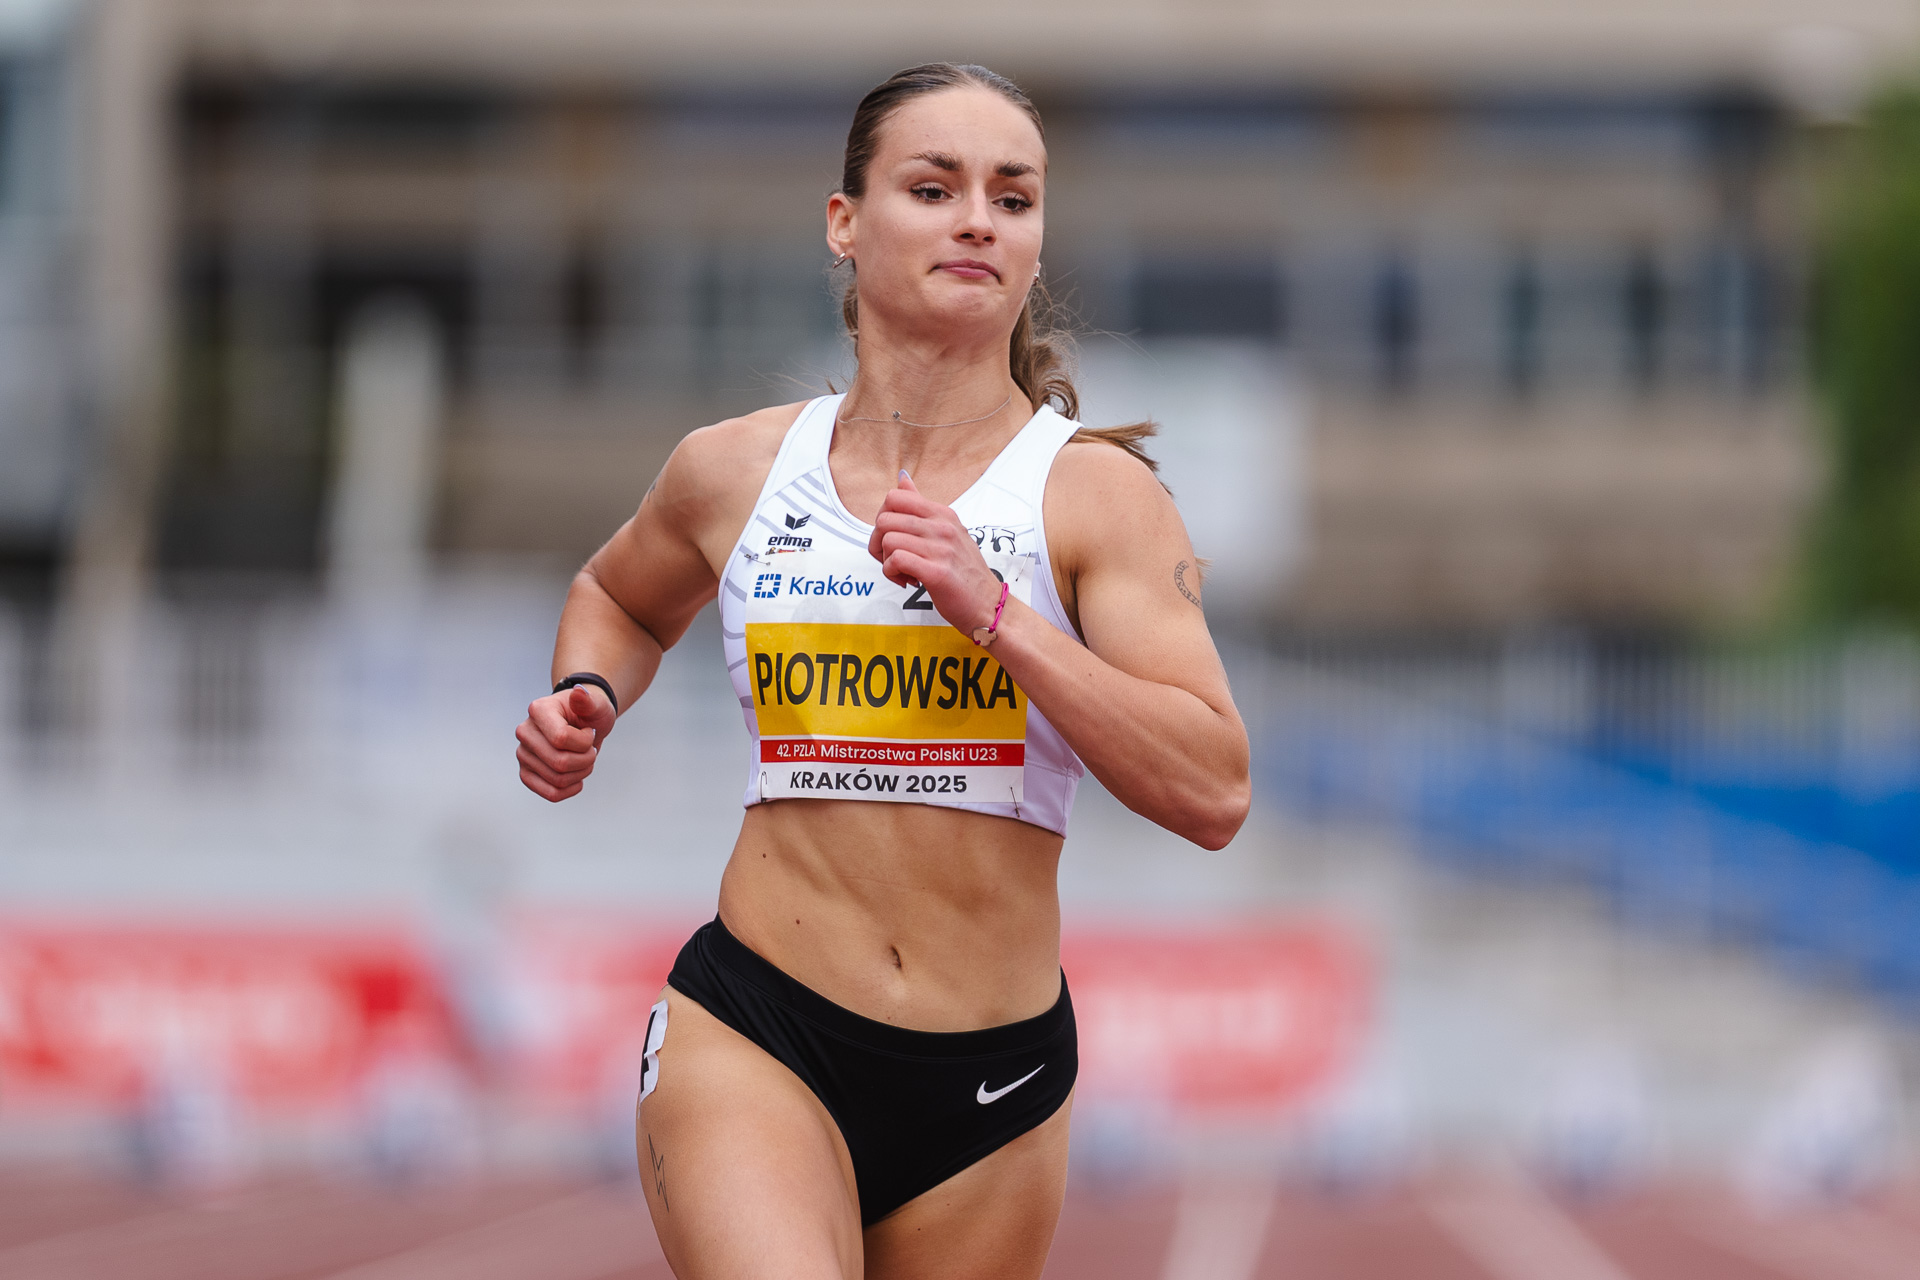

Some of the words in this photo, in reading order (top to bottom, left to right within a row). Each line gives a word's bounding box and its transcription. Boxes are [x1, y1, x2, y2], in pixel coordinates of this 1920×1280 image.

[767, 533, 813, 548] erima
[788, 574, 875, 597] Kraków
[754, 652, 1017, 710] PIOTROWSKA
[776, 744, 792, 758] 42.
[793, 743, 816, 757] PZLA
[820, 744, 916, 761] Mistrzostwa
[920, 747, 965, 761] Polski
[969, 747, 998, 761] U23
[789, 767, 900, 793] KRAKÓW
[905, 775, 967, 793] 2025
